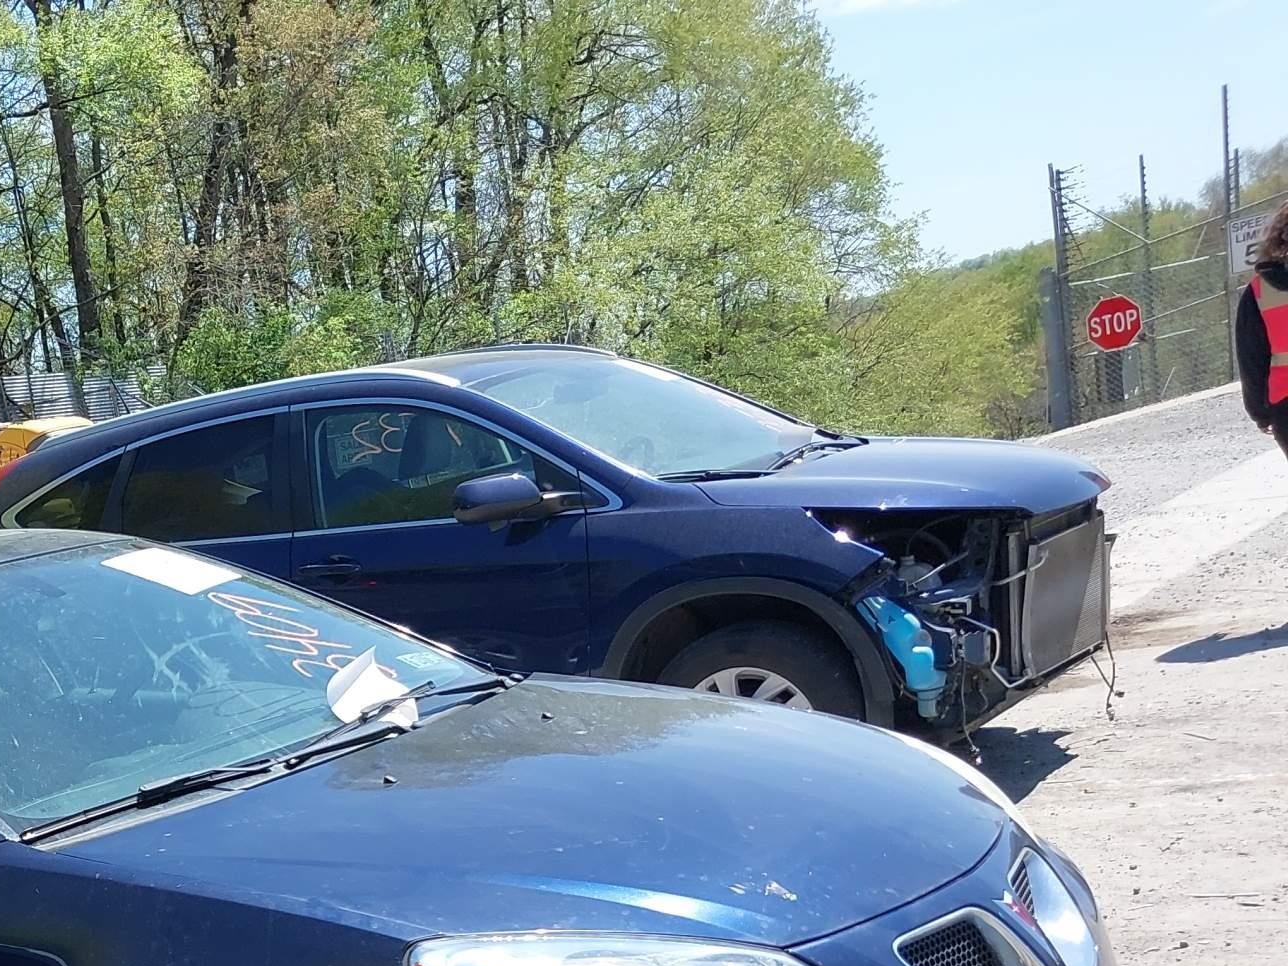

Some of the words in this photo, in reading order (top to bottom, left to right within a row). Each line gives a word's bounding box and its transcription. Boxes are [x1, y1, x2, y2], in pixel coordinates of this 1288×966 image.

[1231, 215, 1267, 232] SPEE
[1235, 230, 1260, 243] LIM
[1090, 309, 1138, 338] STOP
